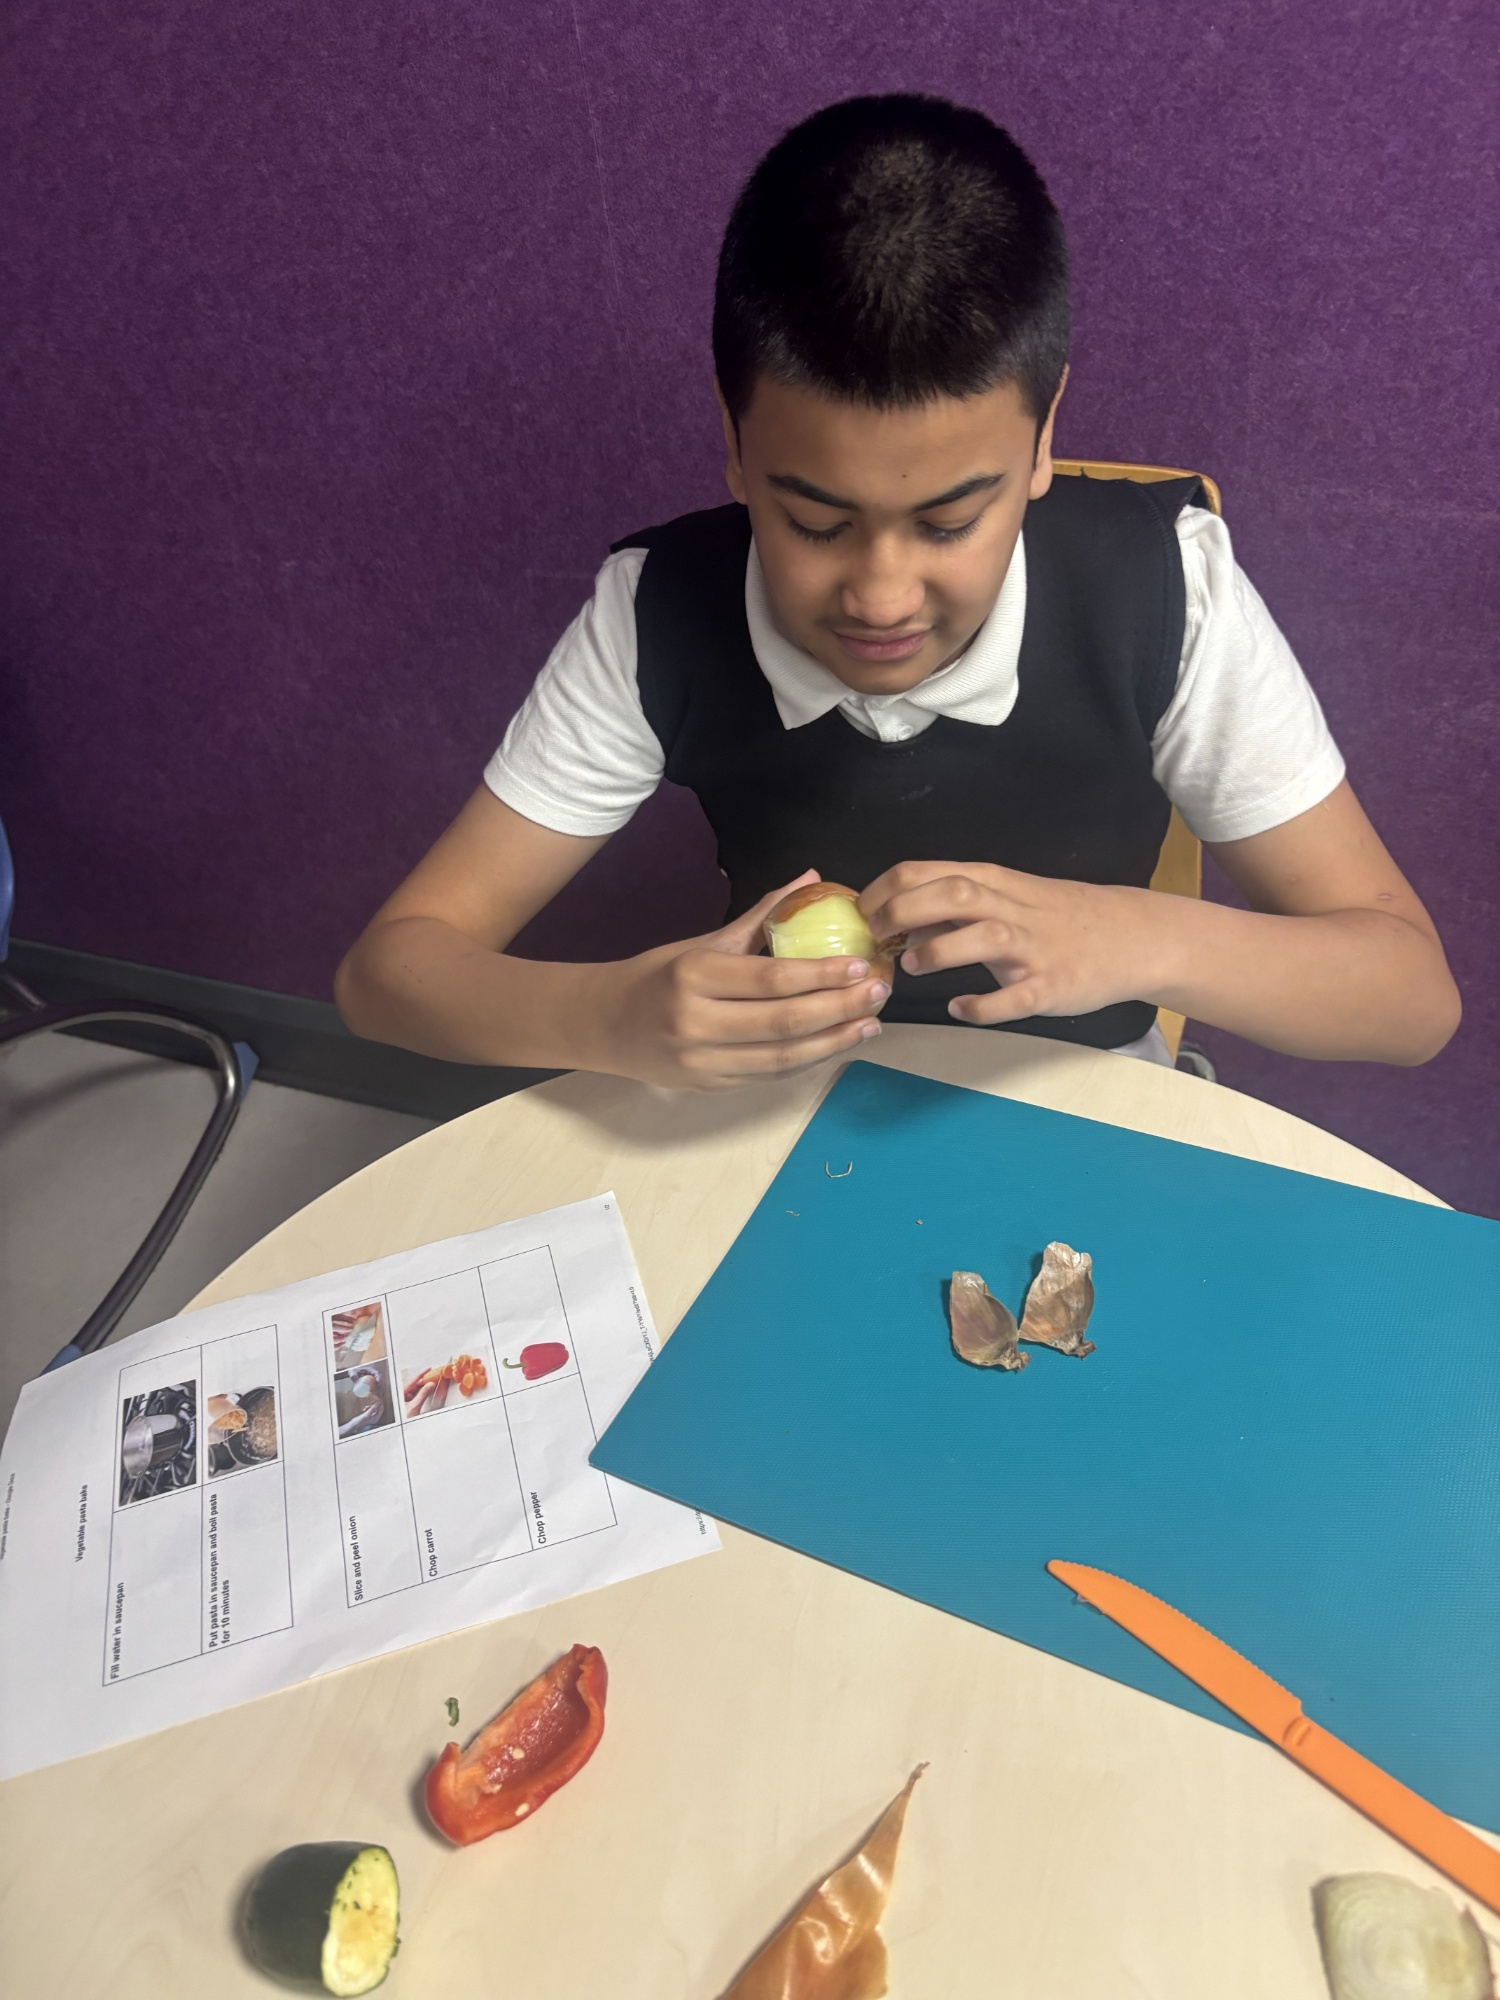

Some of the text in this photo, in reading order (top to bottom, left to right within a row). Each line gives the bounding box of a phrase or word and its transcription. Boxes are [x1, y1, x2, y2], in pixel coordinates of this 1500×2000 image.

[75, 1485, 88, 1562] Vegetable pasta bake
[424, 1528, 438, 1577] Chop carrot
[530, 1491, 546, 1544] Chop pepper
[208, 1493, 219, 1648] Put pasta in saucepan and boil pasta
[348, 1515, 363, 1602] Slice and peel onion
[110, 1582, 125, 1679] Fill water in saucepan
[220, 1579, 230, 1644] for 10 minutes
